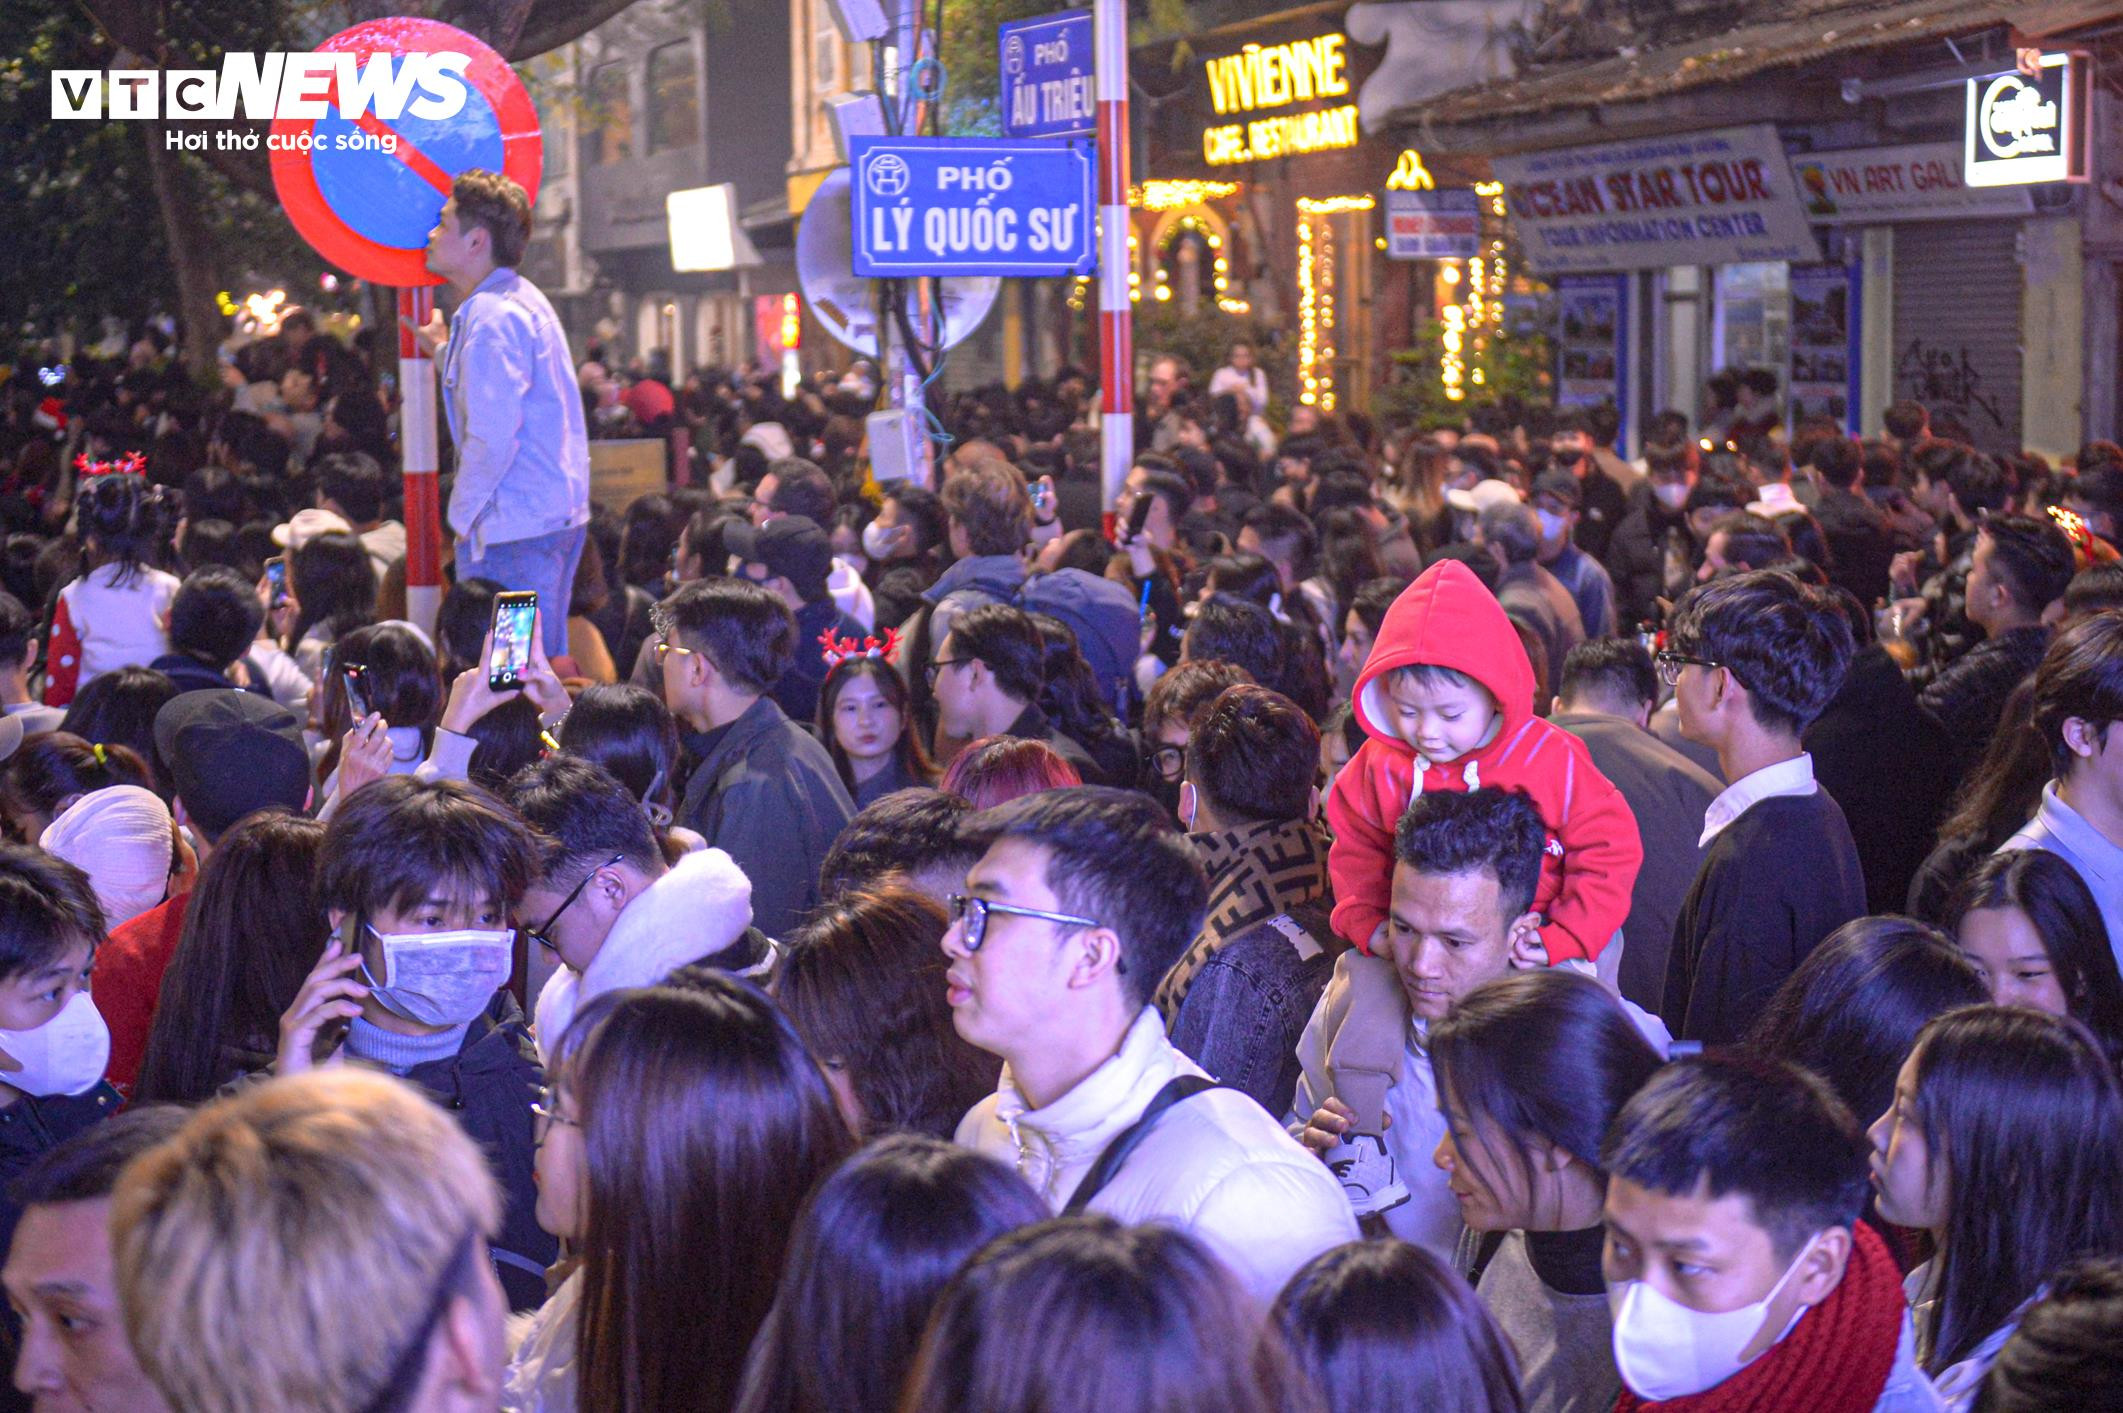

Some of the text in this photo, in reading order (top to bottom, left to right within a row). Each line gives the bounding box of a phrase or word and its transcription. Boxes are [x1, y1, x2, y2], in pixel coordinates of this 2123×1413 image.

[1034, 28, 1068, 66] PHỐ
[1041, 67, 1095, 128] TRIỆU
[936, 156, 1013, 191] PHỐ
[1606, 166, 1682, 211] STAR
[1681, 158, 1770, 204] TOUR
[1864, 164, 1906, 193] ART
[873, 193, 1078, 256] LÝ QUỐC SƯ
